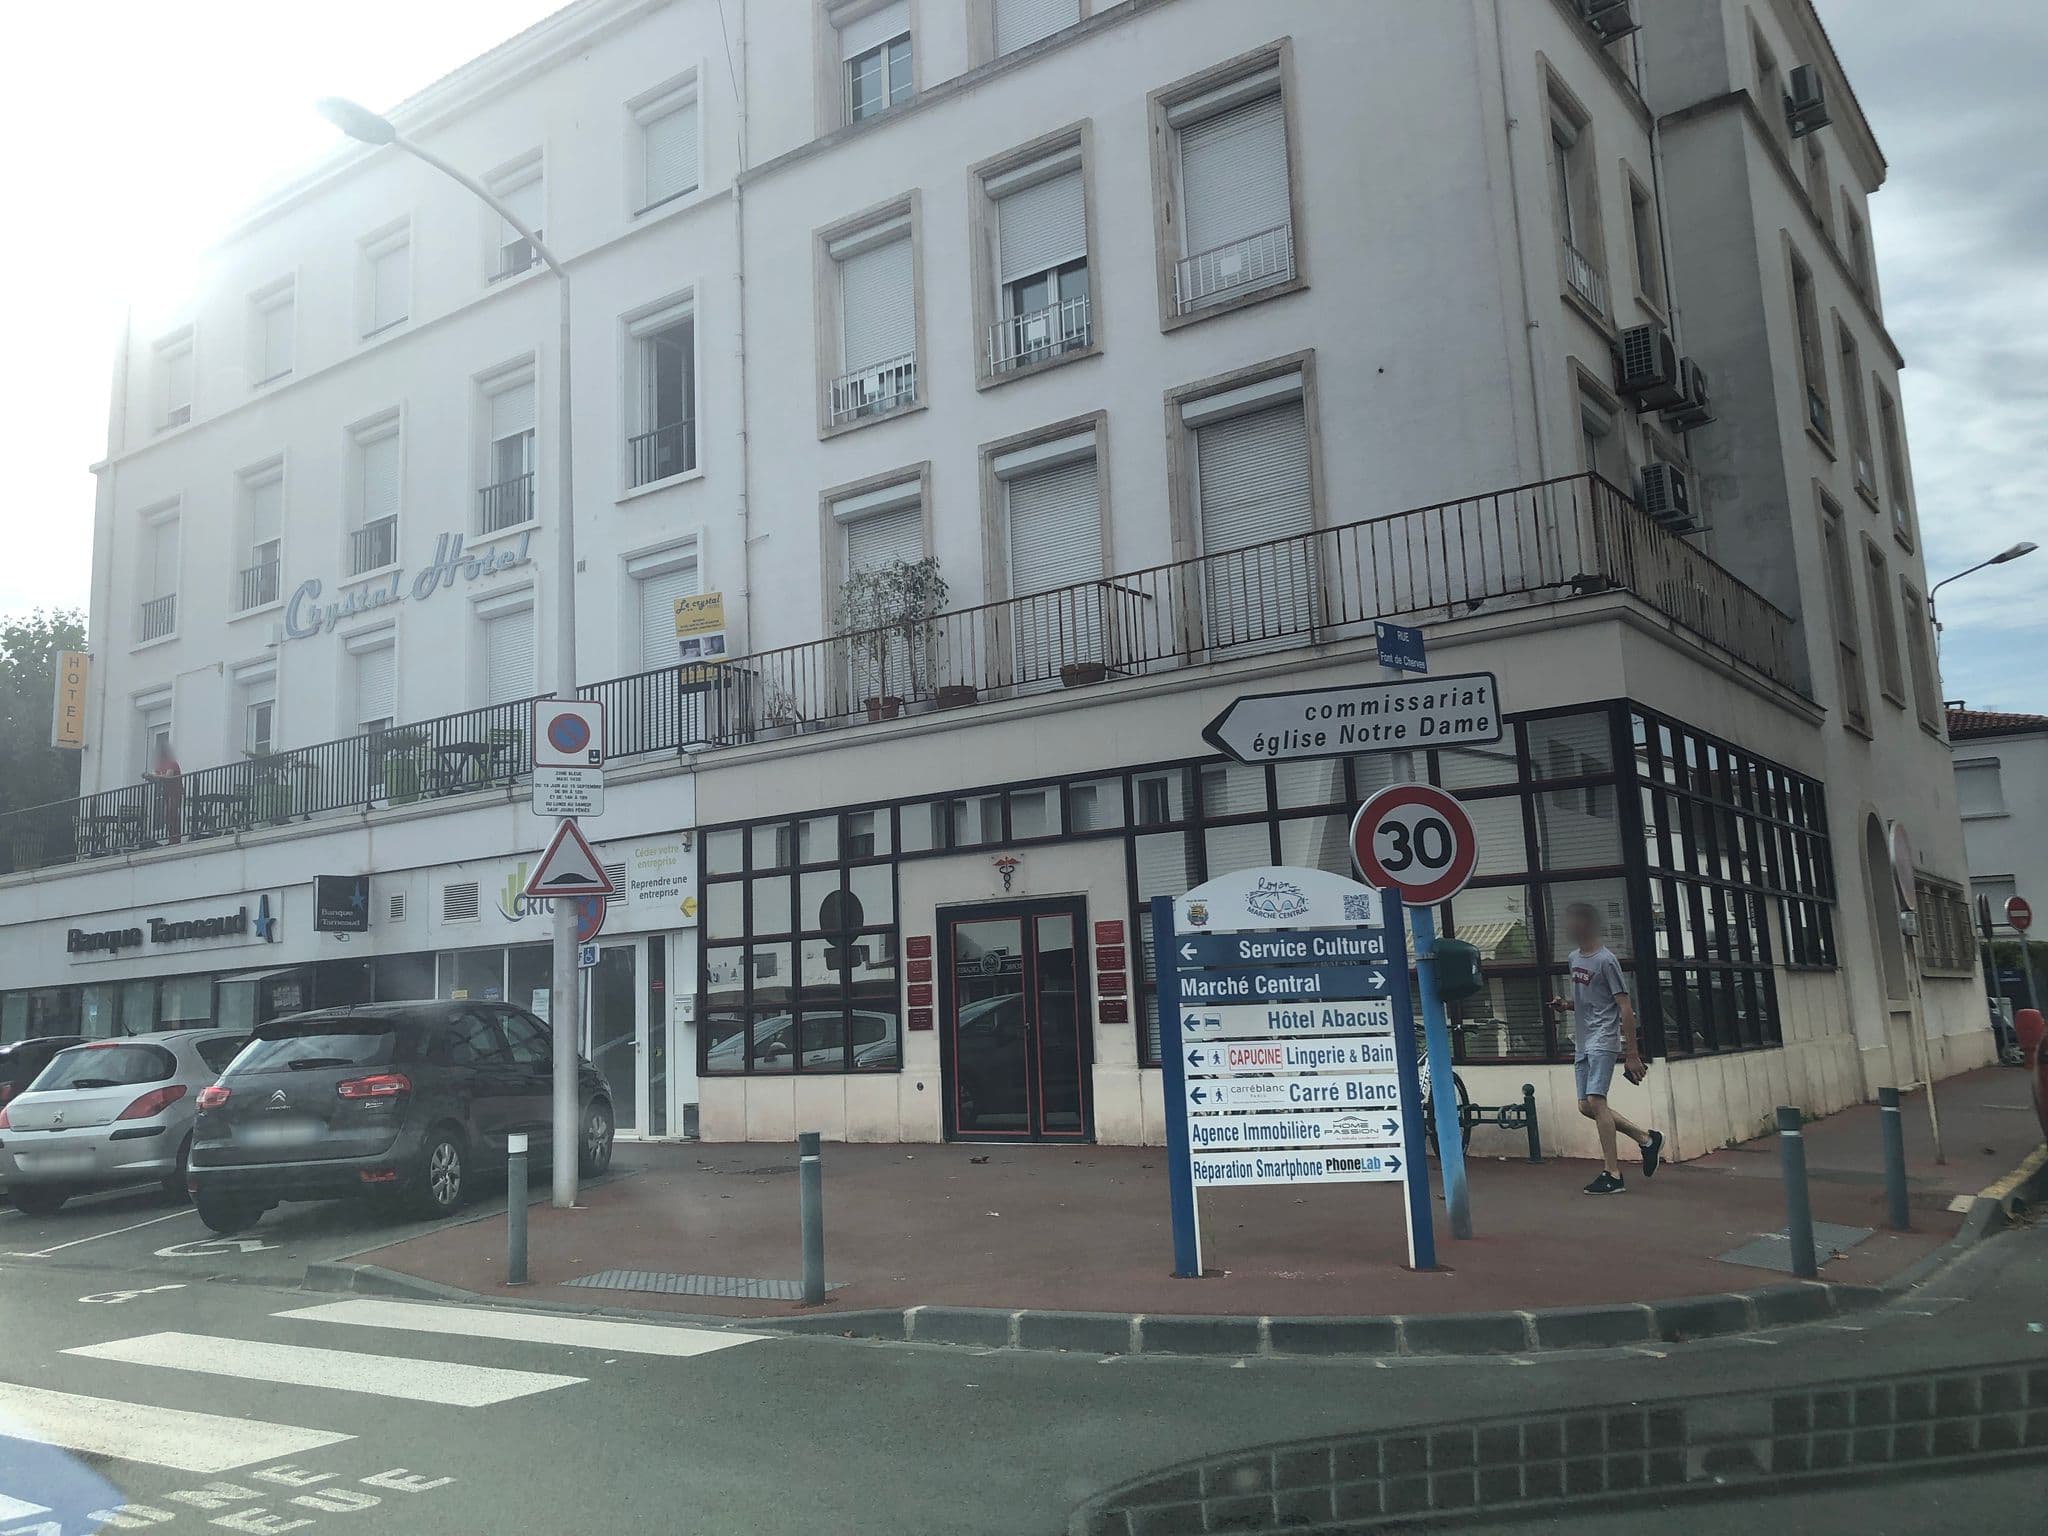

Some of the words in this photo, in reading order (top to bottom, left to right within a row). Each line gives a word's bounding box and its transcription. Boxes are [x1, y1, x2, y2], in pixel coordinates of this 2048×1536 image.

[286, 570, 401, 639] Crystal
[412, 532, 531, 600] Hotel
[1397, 630, 1409, 642] RUE
[1394, 654, 1402, 665] de
[66, 656, 79, 734] HOTEL
[1305, 686, 1487, 721] commissariat
[1253, 730, 1327, 756] église
[1339, 723, 1406, 744] Notre
[1419, 714, 1489, 737] Dame
[1377, 817, 1452, 871] 30
[637, 857, 677, 869] entreprise
[631, 877, 671, 891] Reprendre
[672, 875, 688, 885] une
[639, 888, 679, 899] entreprise
[1258, 877, 1297, 892] Royan
[321, 908, 353, 917] Banque
[1278, 907, 1309, 919] CENTRAL
[67, 928, 143, 954] Banque
[1239, 939, 1307, 959] Service
[1313, 936, 1384, 956] Culturel
[1181, 975, 1249, 997] Marché
[1255, 974, 1320, 994] Central
[1268, 1009, 1315, 1030] Hôtel
[1322, 1009, 1388, 1028] Abacus
[1229, 1047, 1281, 1066] CAPUCINE
[1286, 1045, 1345, 1068] Lingerie
[1349, 1050, 1358, 1063] &
[1361, 1044, 1394, 1062] Bain
[1230, 1083, 1285, 1093] carréblanc
[1289, 1083, 1339, 1102] Carré
[1346, 1081, 1397, 1100] Blanc
[1192, 1123, 1239, 1146] Agence
[1243, 1120, 1321, 1141] Immobilière
[1193, 1158, 1253, 1183] Réparation
[1257, 1157, 1323, 1181] Smartphone
[1326, 1156, 1381, 1171] PhoneLab
